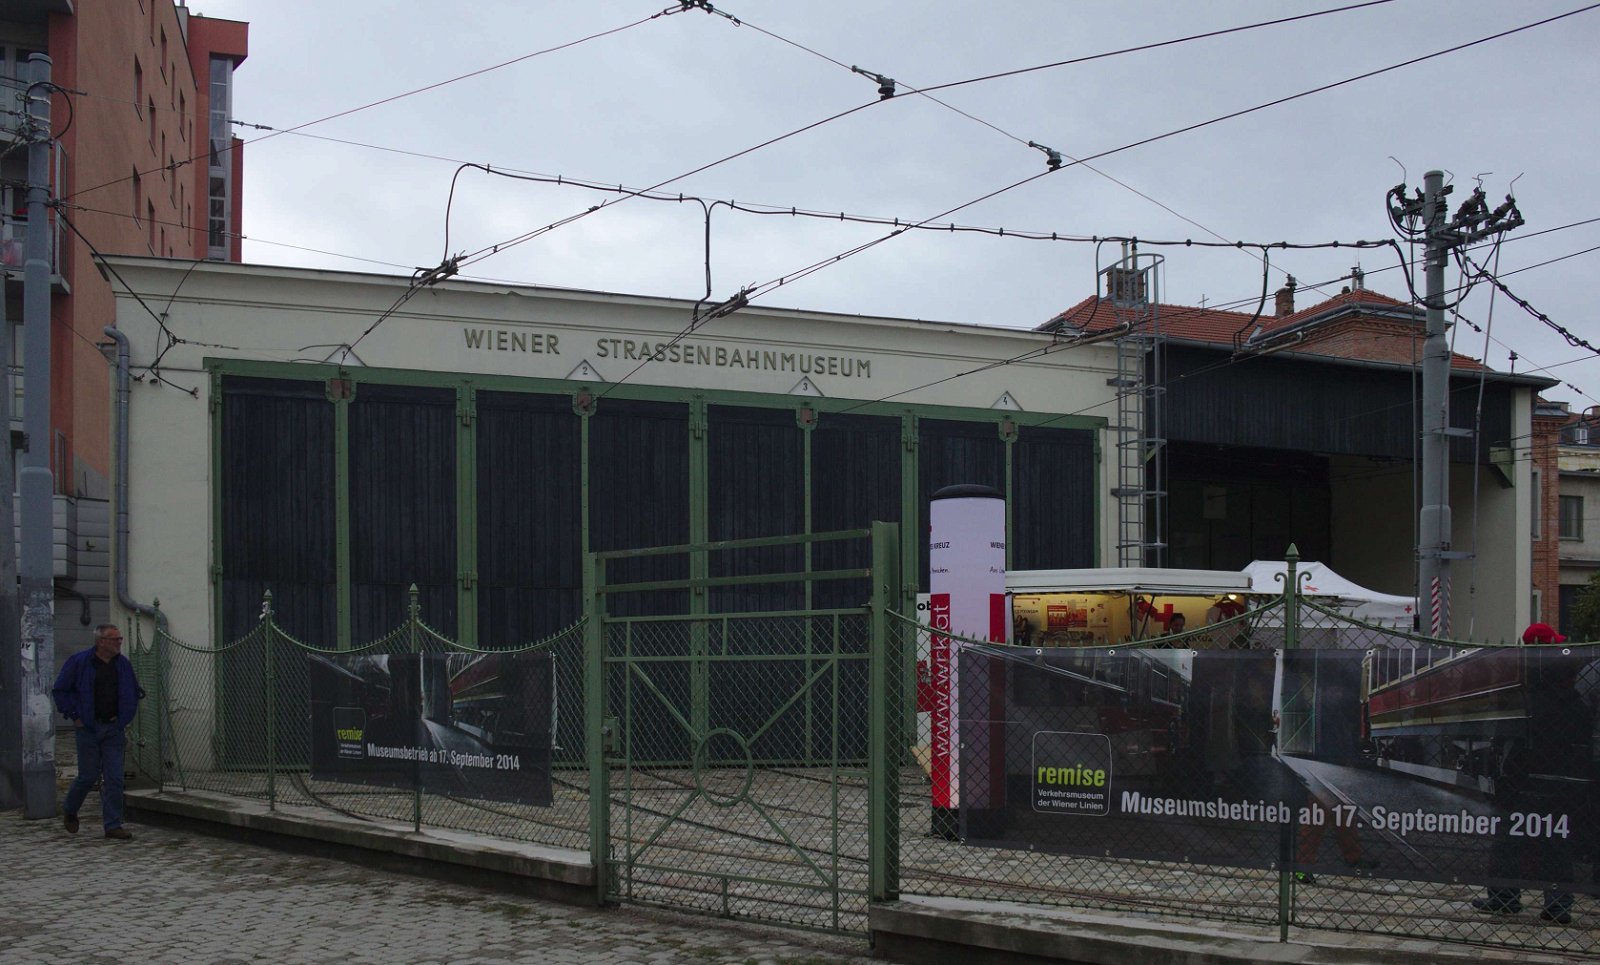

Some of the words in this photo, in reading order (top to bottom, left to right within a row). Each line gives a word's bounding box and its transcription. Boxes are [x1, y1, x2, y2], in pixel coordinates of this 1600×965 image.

[464, 328, 560, 354] WIENER
[596, 338, 872, 379] STRASSENBAHNMUSEUM
[582, 367, 588, 375] 2
[802, 382, 808, 392] 3
[337, 727, 362, 741] remise
[367, 743, 429, 762] Museumsbetrieb
[429, 749, 438, 763] ab
[438, 749, 449, 764] 17.
[450, 750, 494, 769] September
[496, 754, 520, 770] 2014
[1037, 763, 1105, 788] remise
[1038, 789, 1104, 800] Verkehrsmuseum
[1037, 799, 1050, 808] der
[1052, 799, 1078, 810] Wiener
[1080, 801, 1104, 811] Linien
[1121, 790, 1291, 824] Museumsbetrieb
[1298, 802, 1325, 826] ab
[1331, 804, 1364, 828] 17.
[1371, 805, 1501, 836] September
[1509, 812, 1569, 839] 2014
